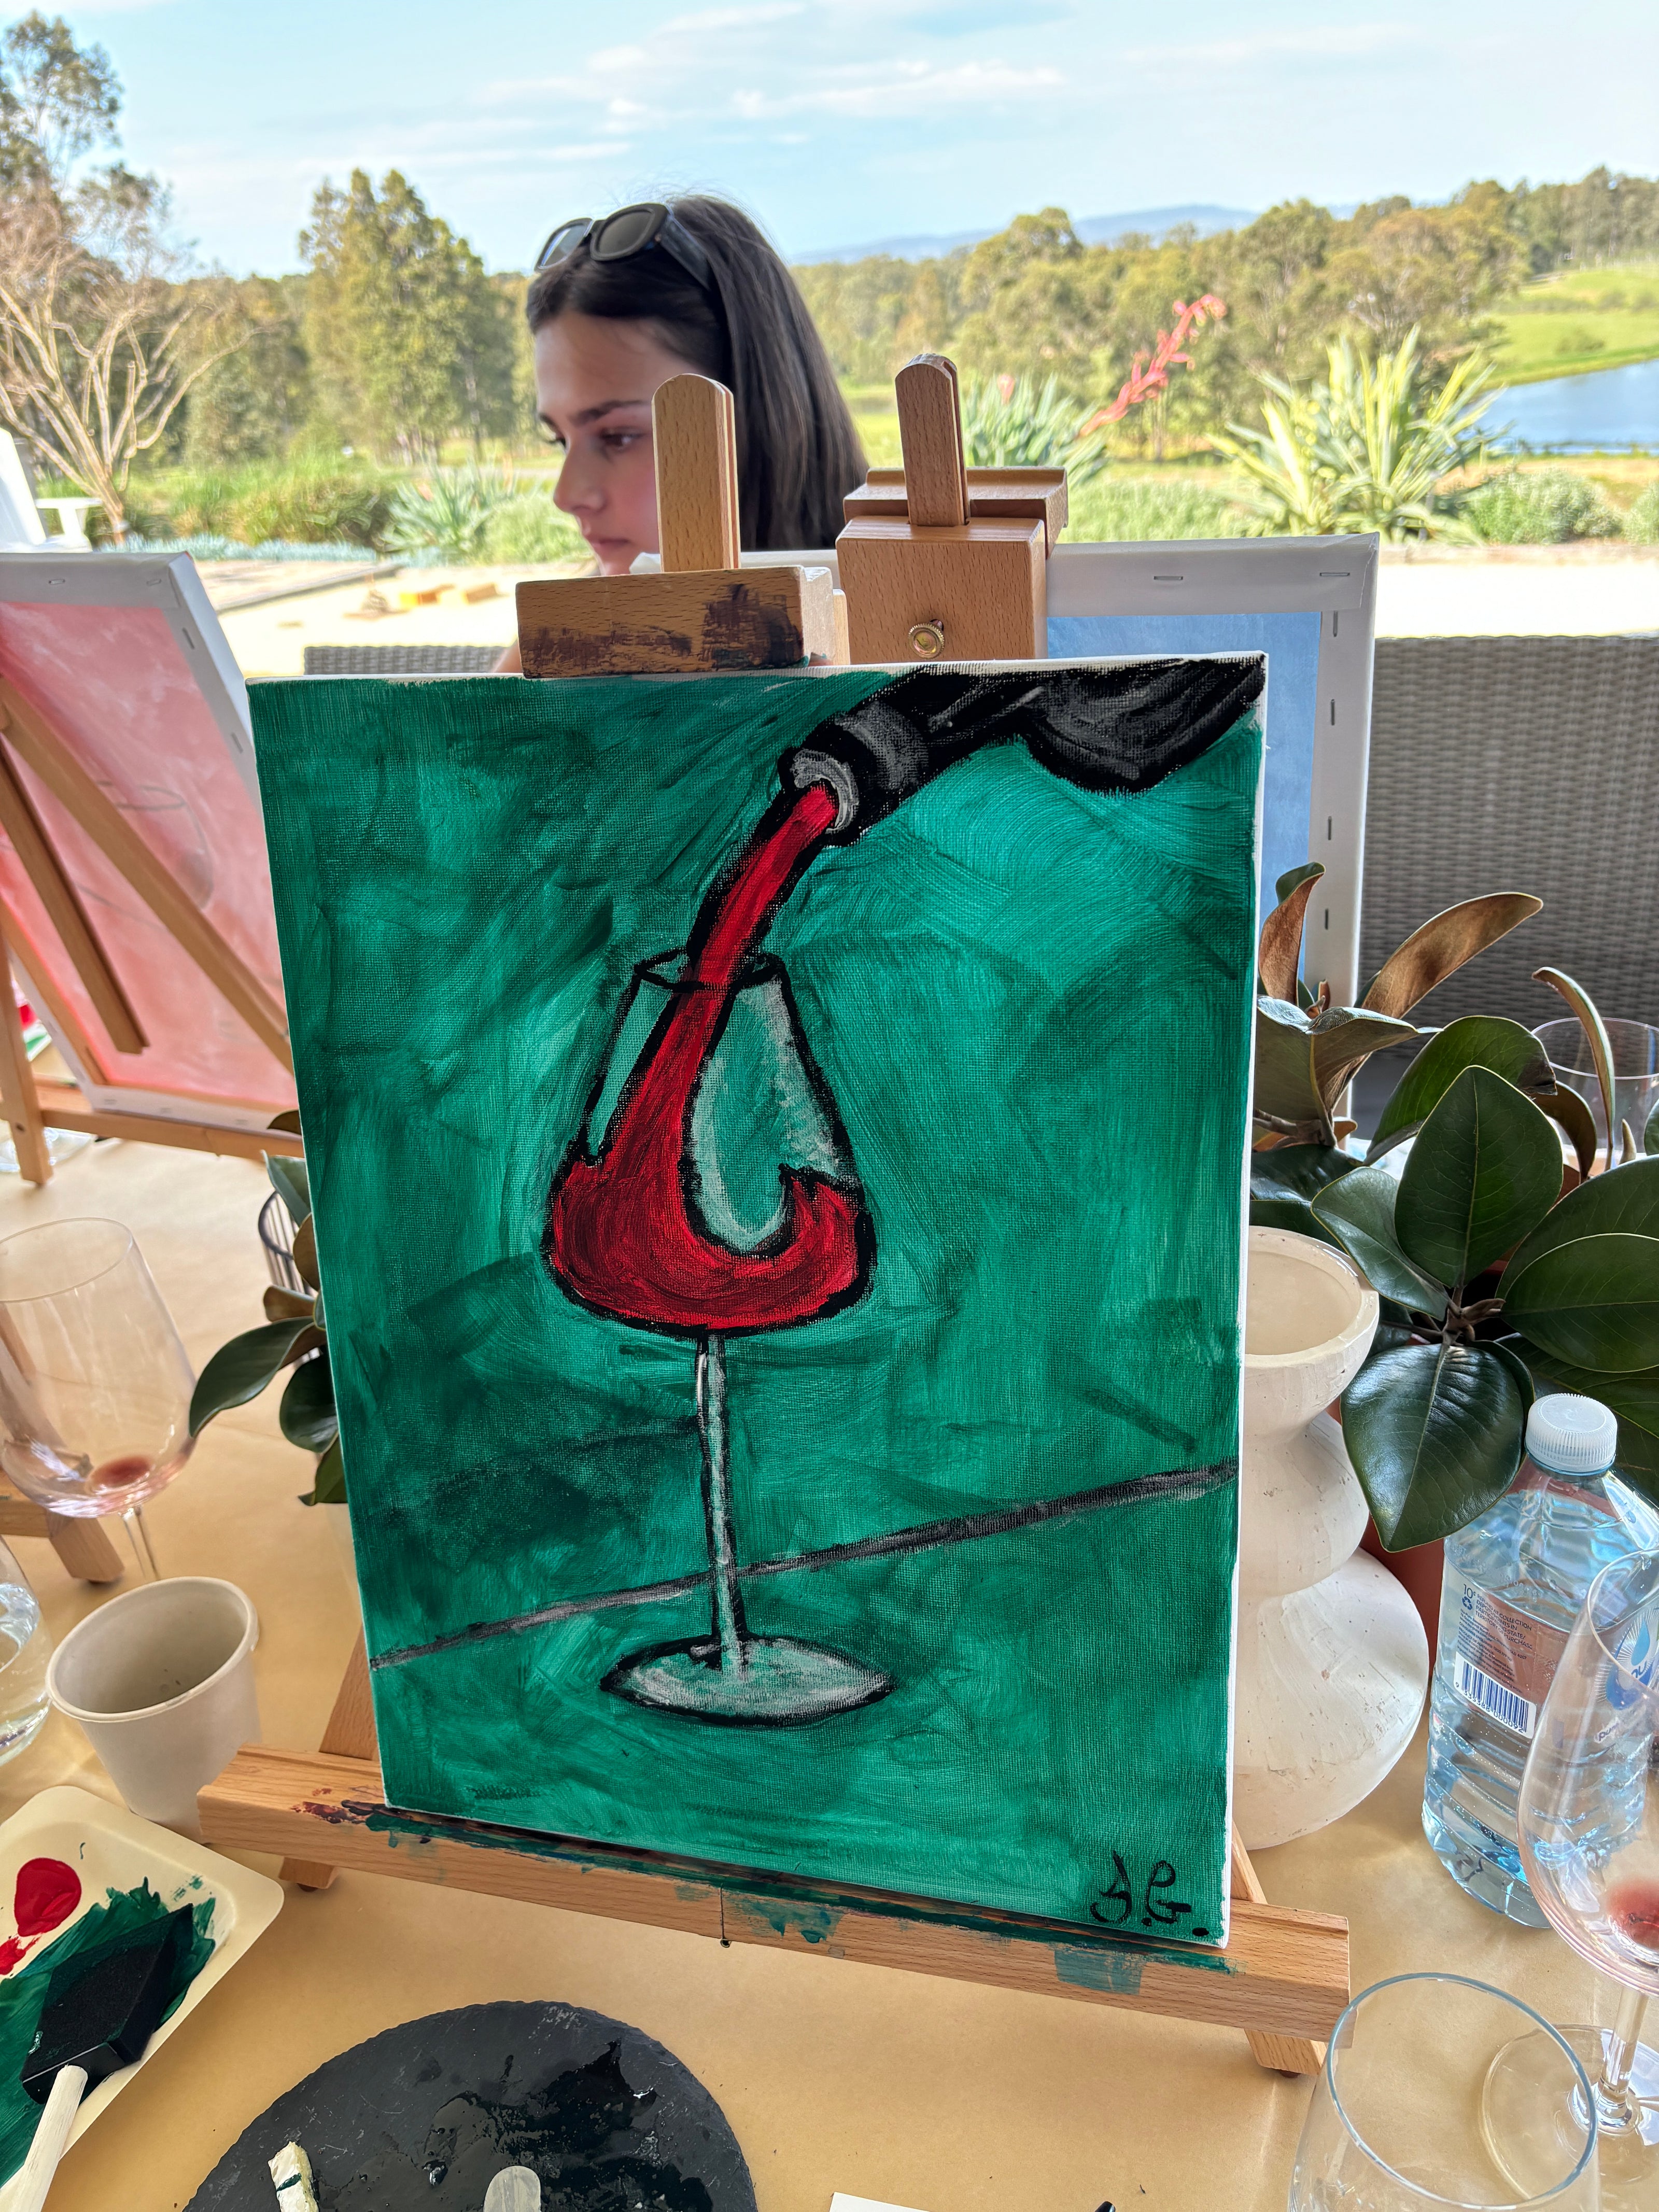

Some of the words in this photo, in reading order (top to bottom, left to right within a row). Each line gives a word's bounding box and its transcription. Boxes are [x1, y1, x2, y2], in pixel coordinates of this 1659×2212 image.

[1475, 1610, 1498, 1629] TERRITORY
[1478, 1594, 1493, 1610] REFUND
[1499, 1613, 1532, 1631] COLLECTION
[1507, 1629, 1526, 1639] STATE/
[1494, 1711, 1523, 1733] 000092
